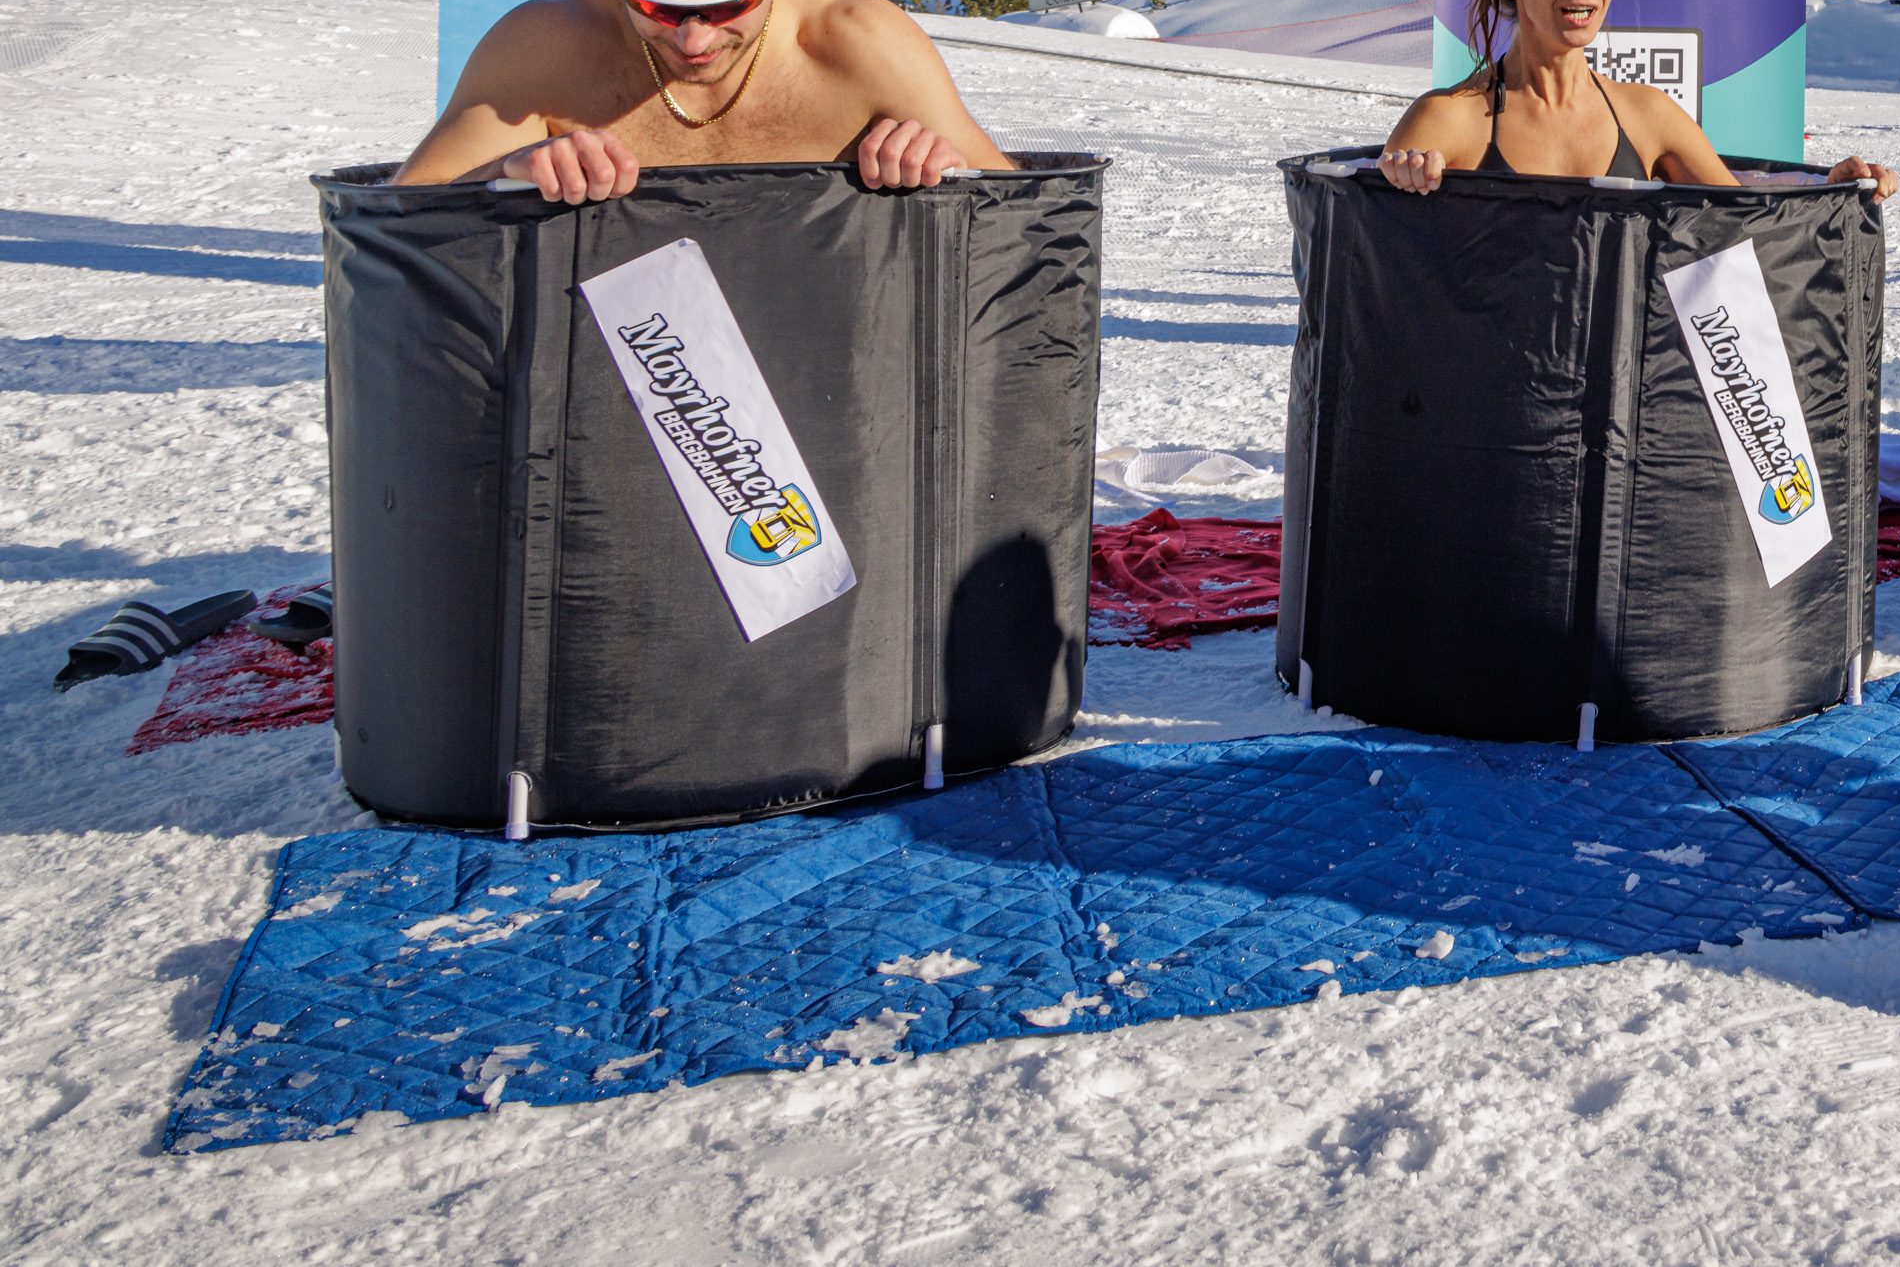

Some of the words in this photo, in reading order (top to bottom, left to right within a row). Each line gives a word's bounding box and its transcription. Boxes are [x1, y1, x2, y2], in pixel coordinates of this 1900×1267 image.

[619, 314, 788, 510] Mayrhofner
[1691, 306, 1797, 476] Mayrhofner
[1716, 390, 1774, 480] BERGBAHNEN
[658, 410, 749, 514] BERGBAHNEN
